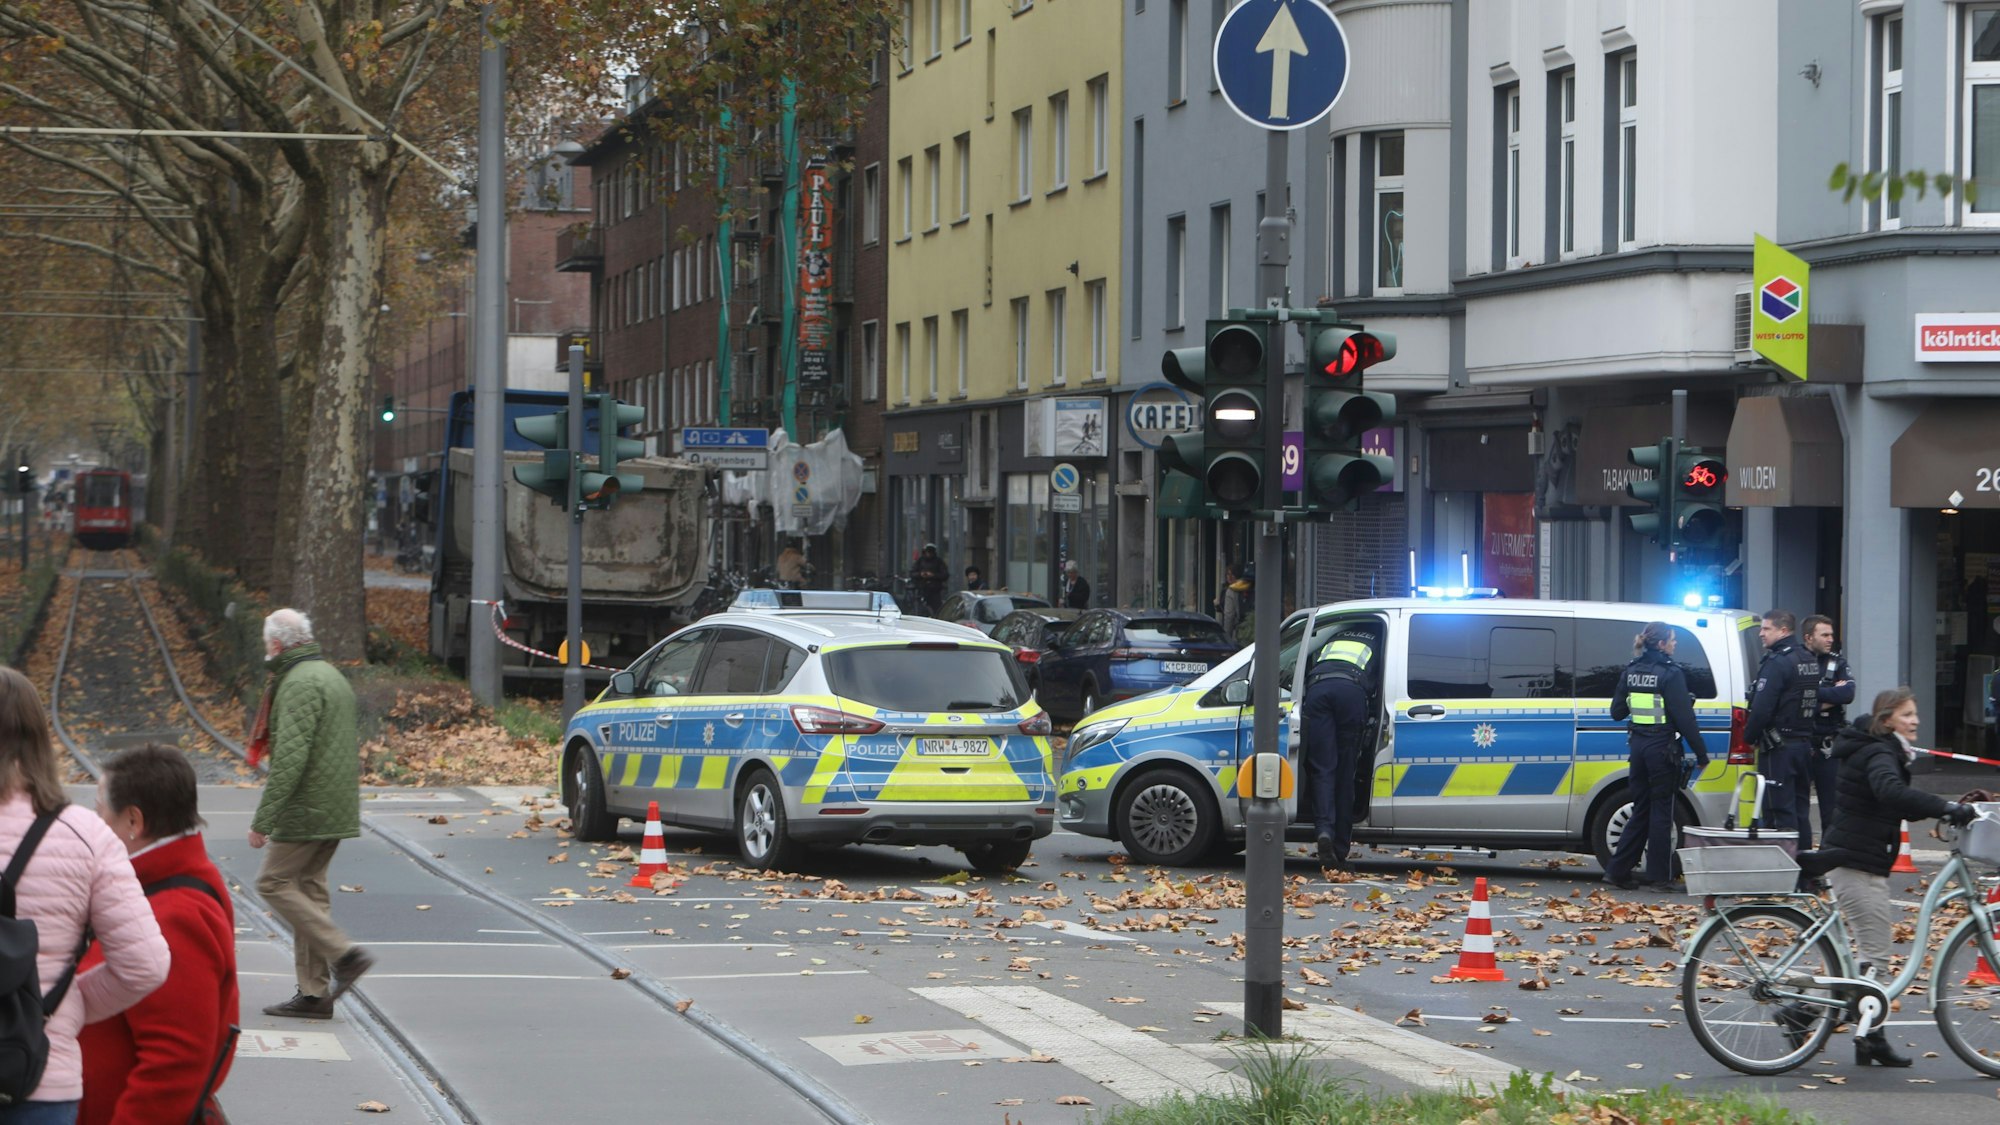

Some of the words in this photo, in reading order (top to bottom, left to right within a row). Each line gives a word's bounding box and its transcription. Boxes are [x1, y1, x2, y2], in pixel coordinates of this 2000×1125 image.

[811, 174, 825, 242] PAUL
[1740, 466, 1776, 489] WILDEN
[1627, 674, 1658, 687] POLIZEI
[619, 722, 657, 741] POLIZEI
[849, 744, 900, 756] POLIZEI
[924, 740, 945, 750] NRW
